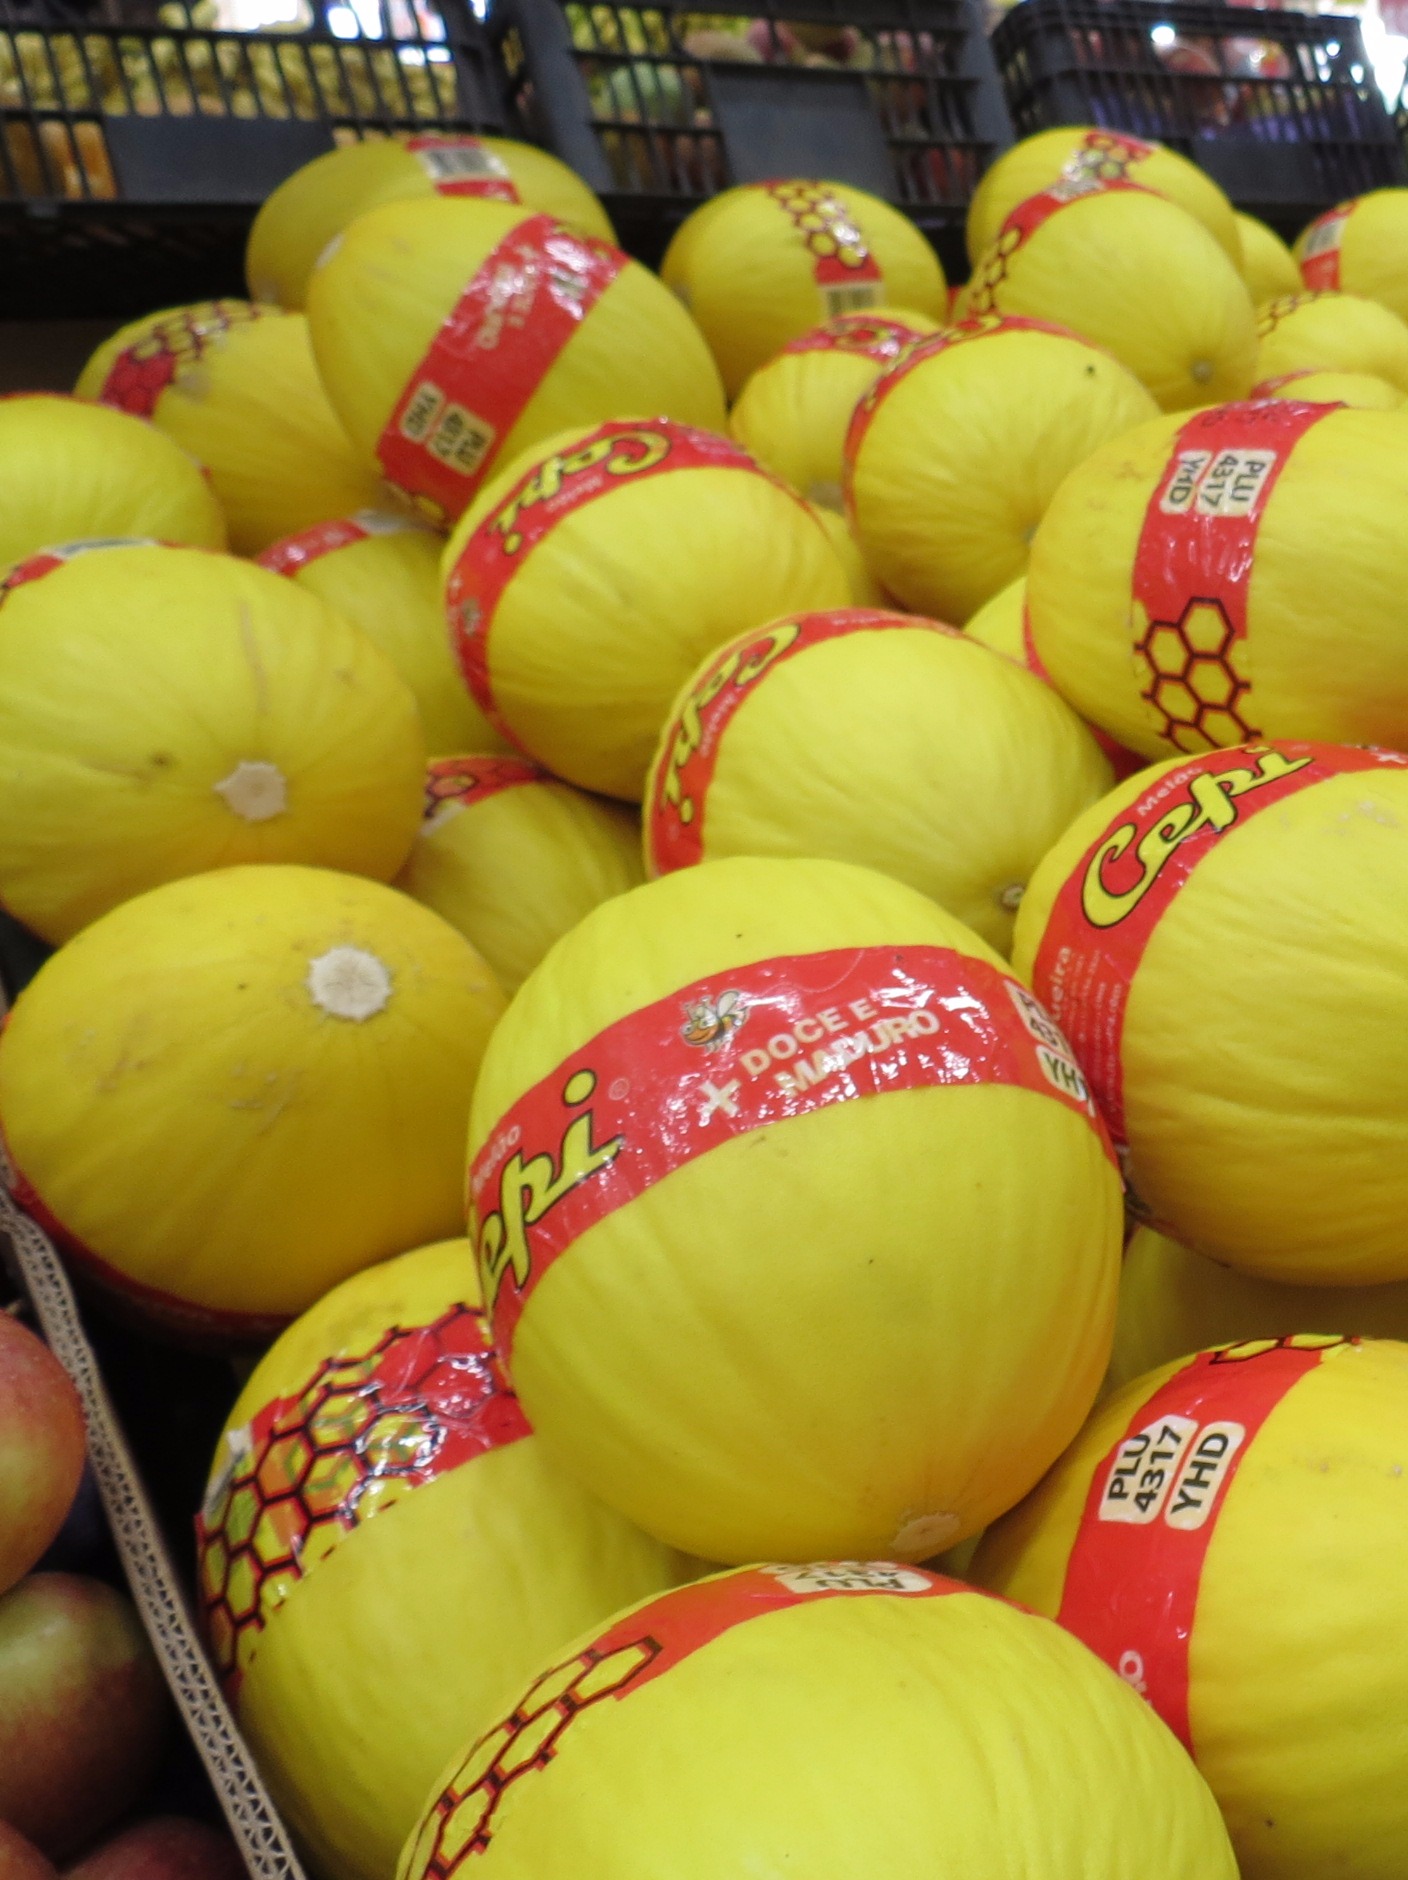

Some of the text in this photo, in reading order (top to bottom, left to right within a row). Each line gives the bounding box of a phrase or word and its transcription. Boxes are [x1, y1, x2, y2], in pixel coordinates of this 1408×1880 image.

[1201, 454, 1238, 507] 4317
[1230, 459, 1266, 503] PLU
[1081, 744, 1315, 930] Cepi
[739, 998, 878, 1077] DOCE E
[773, 1008, 941, 1099] MADURO
[1107, 1433, 1151, 1501] PLU
[1133, 1425, 1182, 1513] 4317
[1170, 1432, 1229, 1514] YHD
